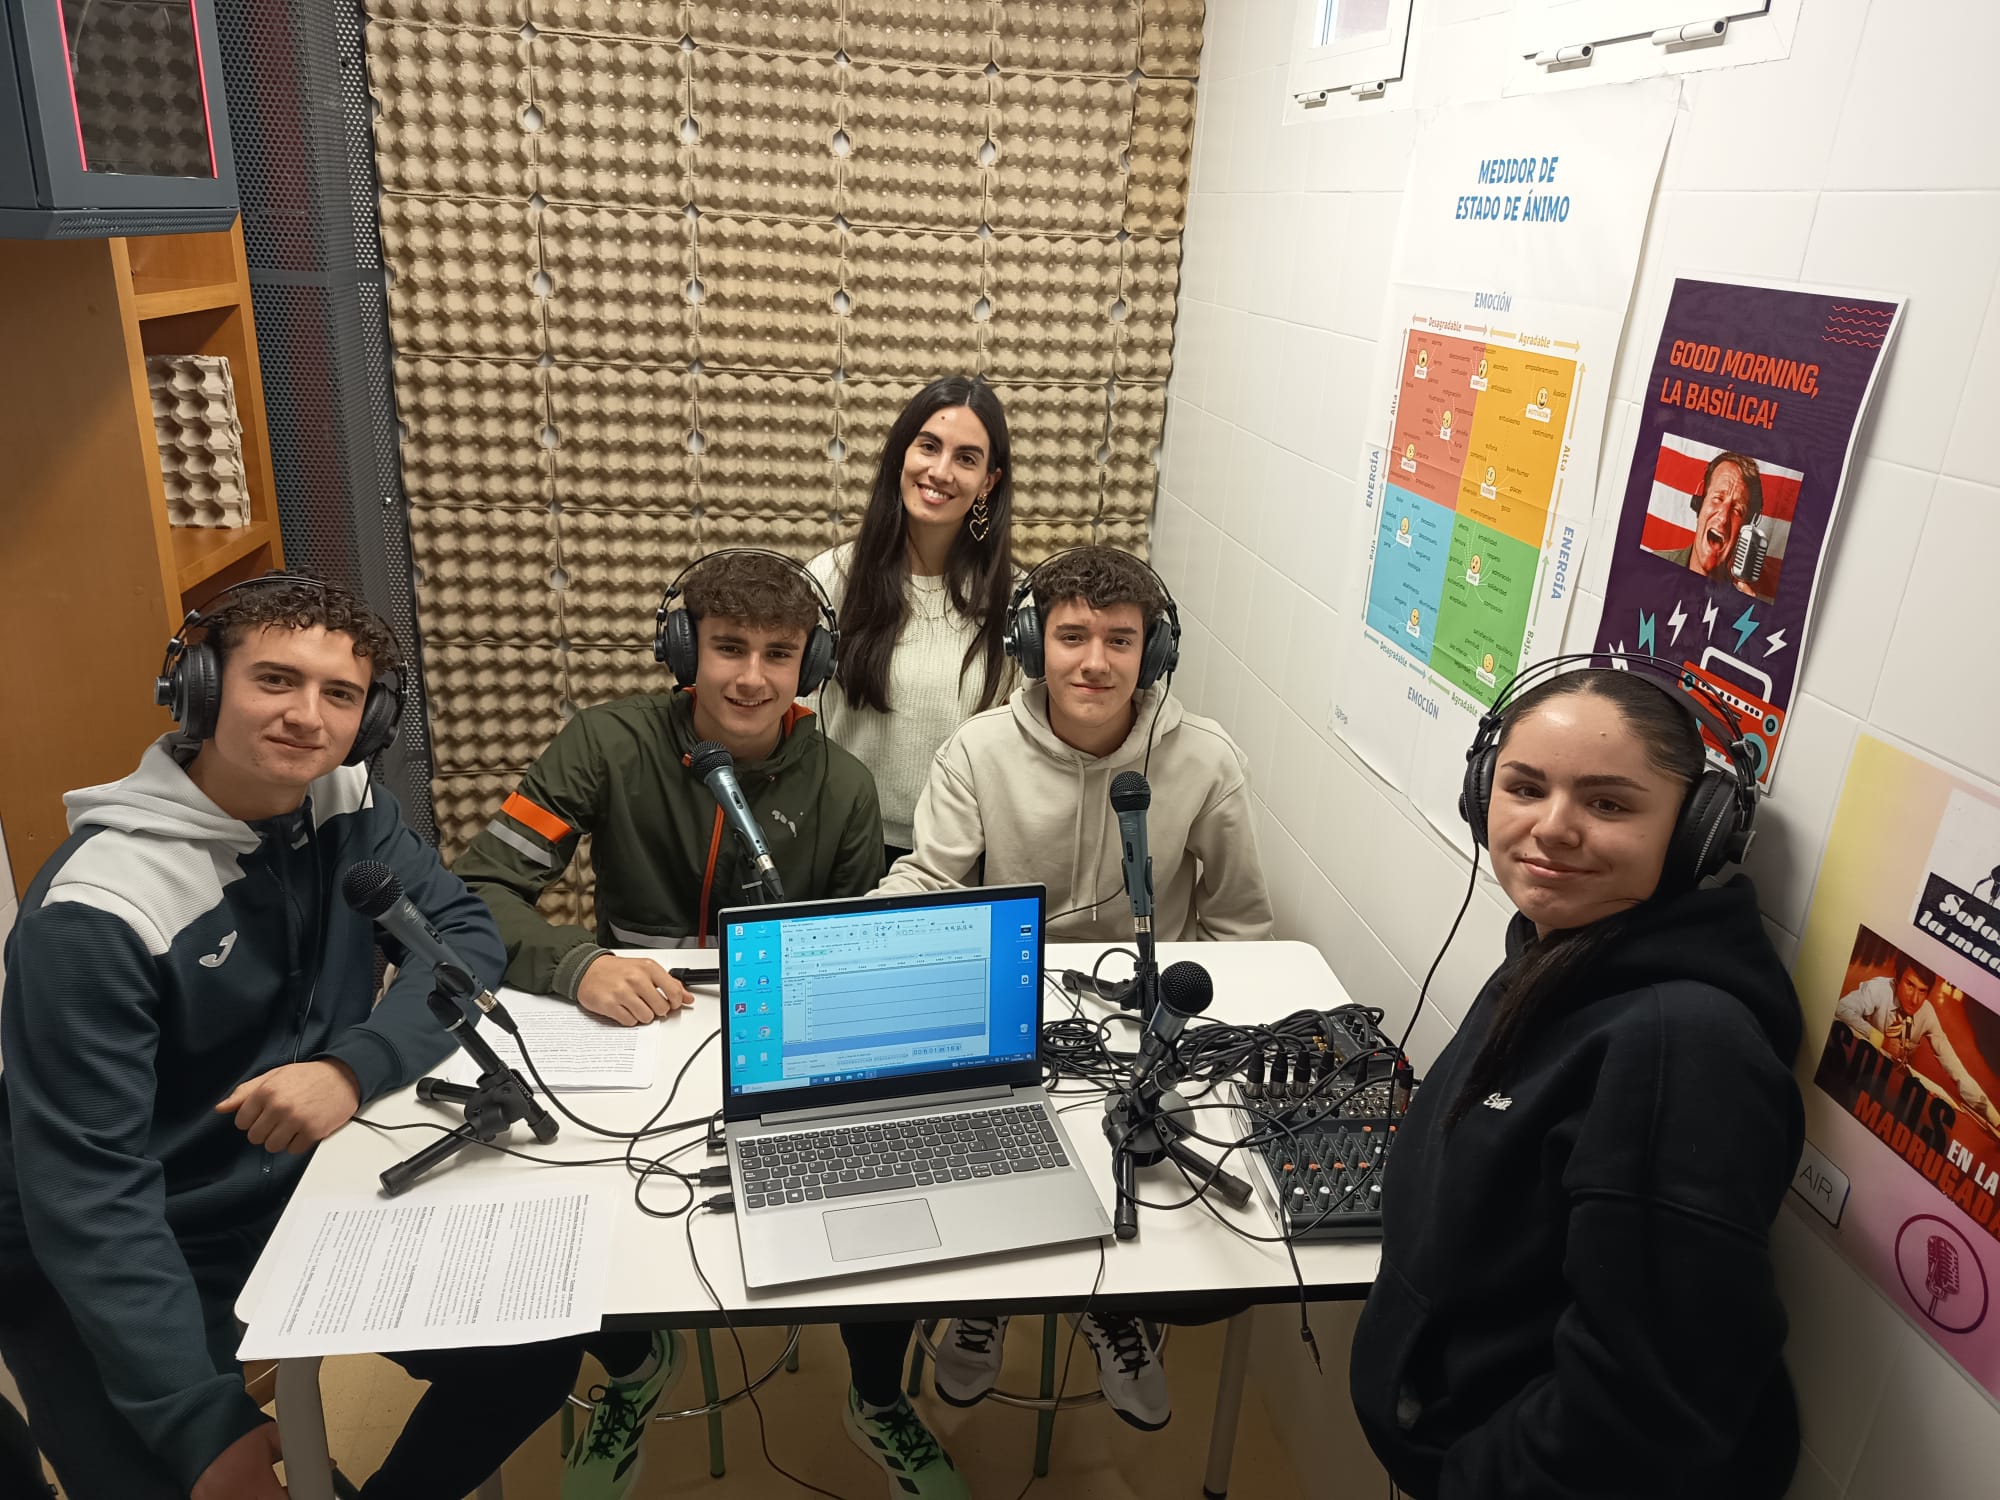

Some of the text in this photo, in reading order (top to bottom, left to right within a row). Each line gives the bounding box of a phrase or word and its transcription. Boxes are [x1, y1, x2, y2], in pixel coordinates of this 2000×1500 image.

[1478, 156, 1559, 184] MEDIDOR DE
[1455, 189, 1570, 222] ESTADO DE ÁNIMO
[1474, 291, 1512, 312] EMOCIÓN
[1428, 316, 1462, 332] Desagradable
[1518, 332, 1551, 348] Agradable
[1669, 339, 1820, 399] GOOD MORNING,
[1659, 377, 1779, 430] LA BASÍLICA!
[1366, 450, 1380, 508] ENERGÍA
[1551, 525, 1574, 600] ENERGÍA
[1407, 686, 1440, 720] EMOCIÓN
[1918, 910, 1946, 936] la
[1939, 893, 2000, 946] Solo
[1799, 1164, 1833, 1204] AIR
[1947, 1139, 1999, 1196] EN LA
